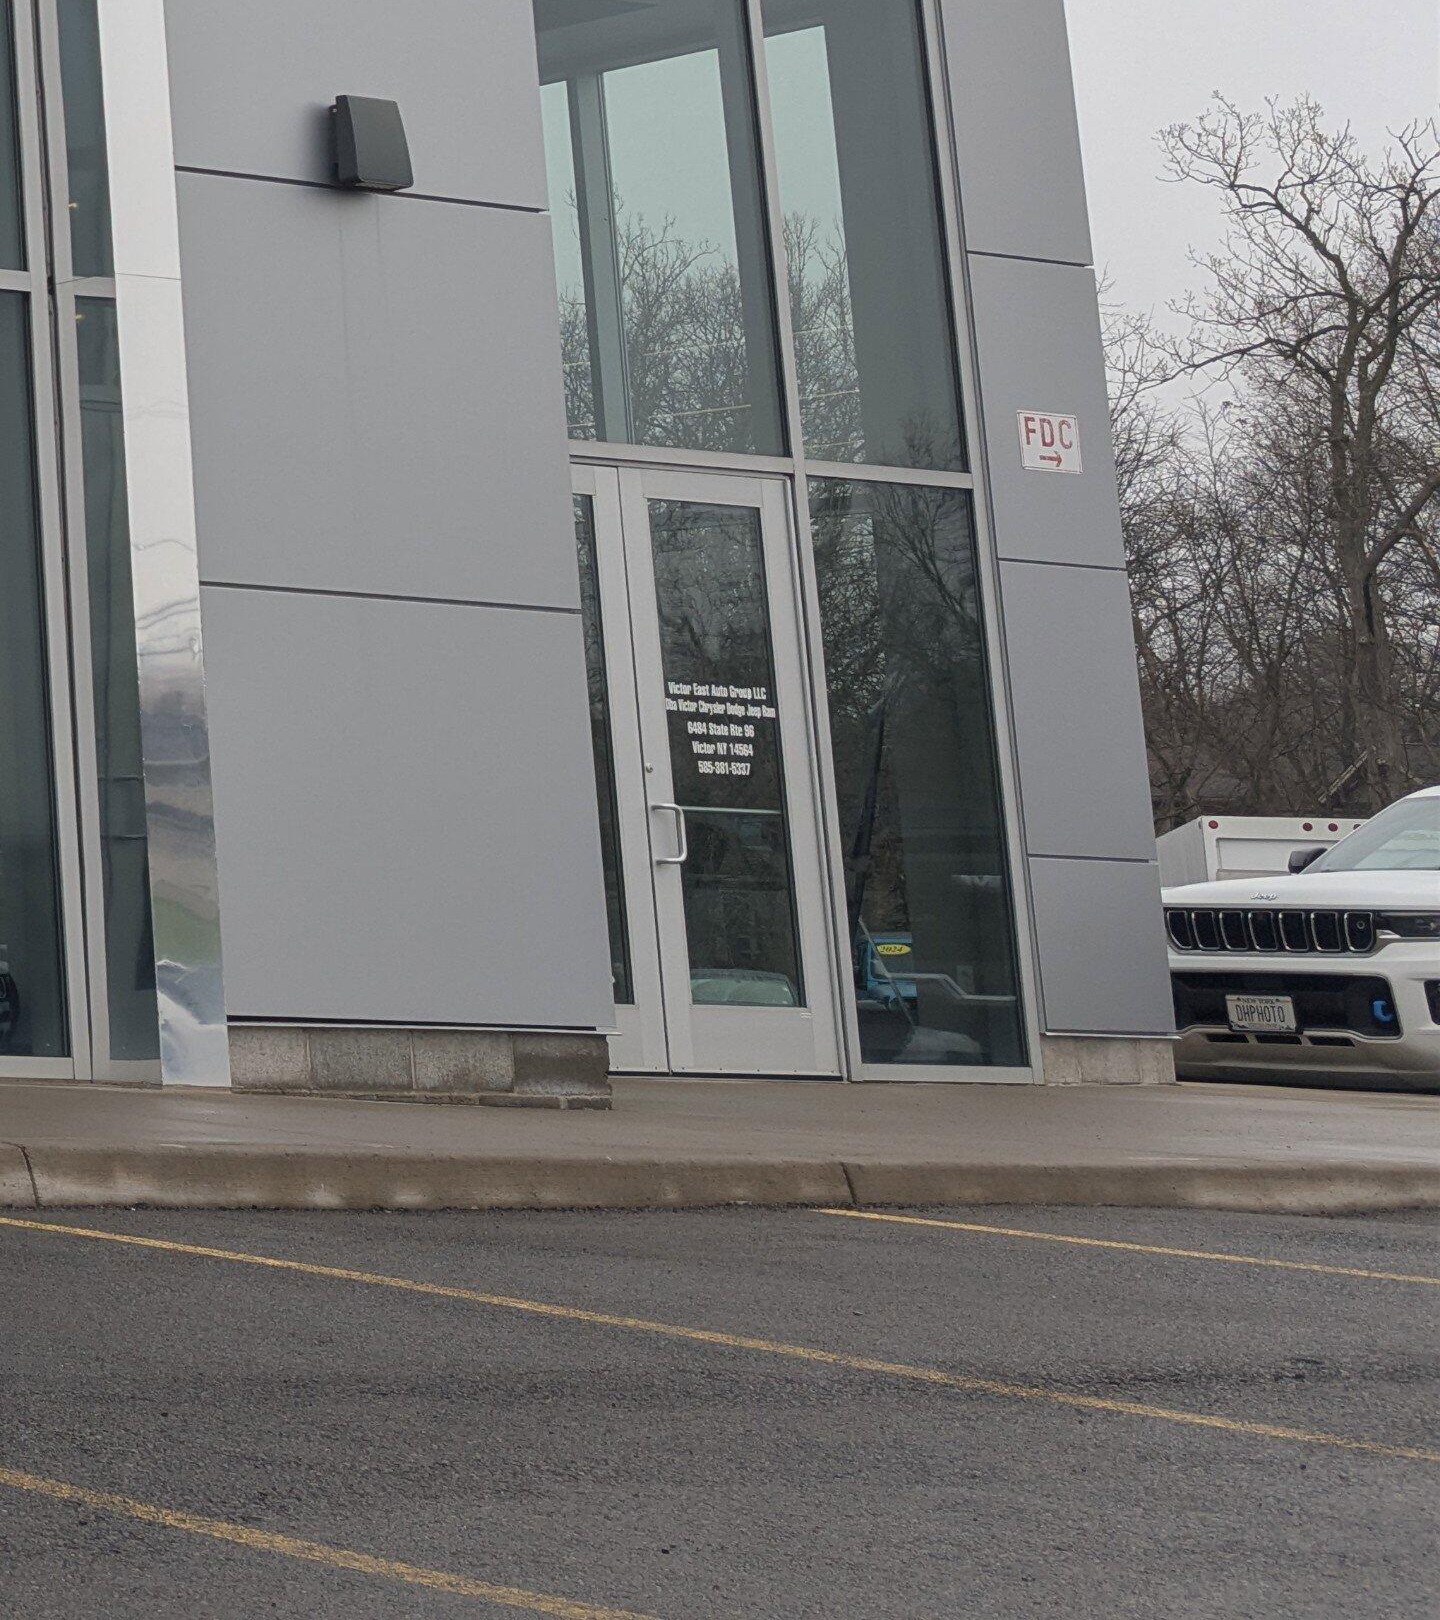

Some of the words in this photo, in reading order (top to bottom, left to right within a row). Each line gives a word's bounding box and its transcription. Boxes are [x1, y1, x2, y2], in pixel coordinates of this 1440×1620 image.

[1024, 416, 1073, 450] FDC
[668, 682, 691, 694] Victor
[693, 683, 709, 696] East
[711, 684, 727, 697] Auto
[729, 685, 751, 699] Group
[753, 687, 766, 699] LLC
[678, 699, 697, 711] Victor
[698, 700, 725, 714] Chrysler
[727, 703, 745, 717] Dodge
[747, 704, 761, 718] Jeep
[762, 705, 775, 718] Ram
[687, 721, 707, 734] 6484
[709, 723, 728, 735] State
[730, 724, 742, 736] Rte
[744, 724, 754, 737] 96
[692, 741, 715, 754] Victor
[729, 743, 753, 756] 14564
